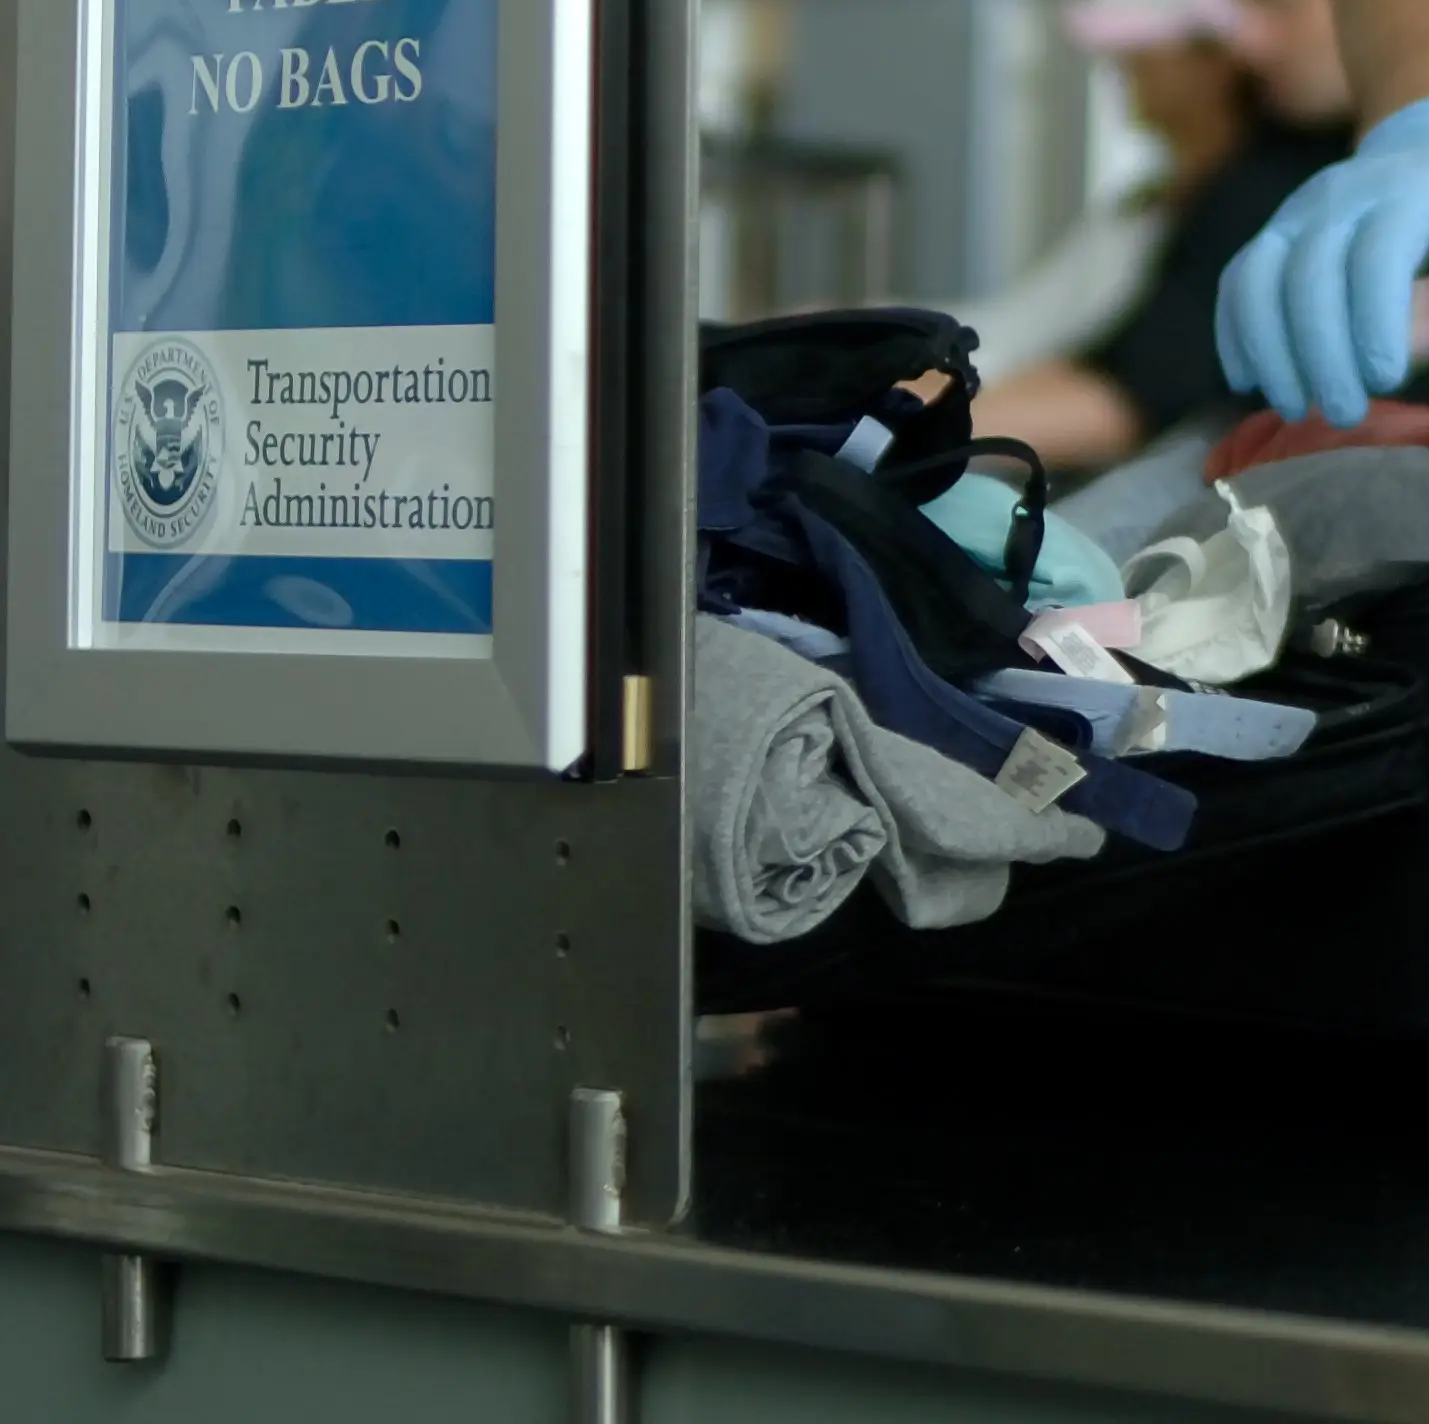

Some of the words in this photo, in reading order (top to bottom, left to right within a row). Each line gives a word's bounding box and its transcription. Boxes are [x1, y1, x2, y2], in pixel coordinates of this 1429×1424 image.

[188, 51, 263, 115] NO
[276, 37, 422, 109] BAGS
[208, 399, 220, 427] OF
[246, 357, 492, 419] Transportation
[244, 419, 381, 482] Security
[117, 454, 167, 539] HOMELAND
[170, 453, 218, 538] SECURITY
[240, 477, 494, 531] Administration
